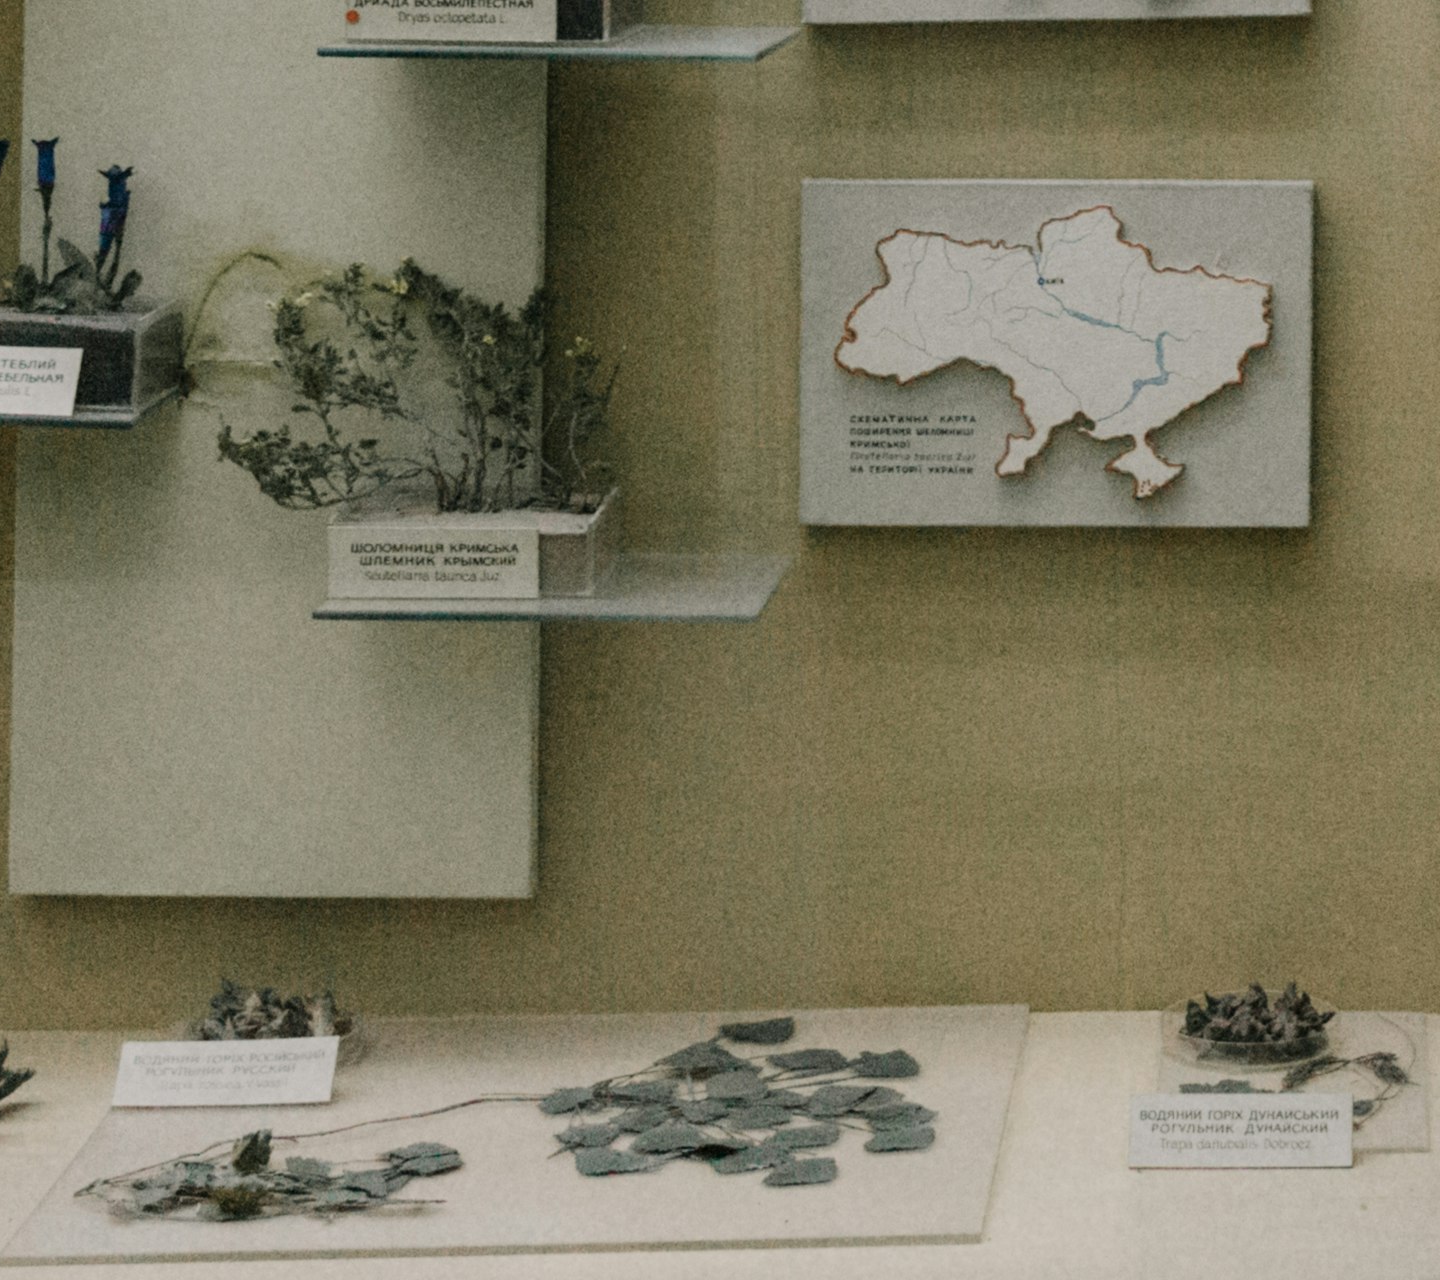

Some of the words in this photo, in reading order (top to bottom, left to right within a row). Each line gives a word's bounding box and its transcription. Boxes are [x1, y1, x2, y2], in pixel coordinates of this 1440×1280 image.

[849, 414, 929, 424] СХЕМАТИЧНА
[940, 415, 976, 423] КАРТА
[849, 427, 912, 436] ПОШИРЕННЯ
[350, 543, 444, 555] ШОЛОМНИЦЯ
[449, 543, 519, 554] КРИМСЬКА
[359, 556, 435, 567] ШЛЕМНИК
[443, 556, 516, 567] КРЫМСКИЙ
[1139, 1109, 1202, 1122] ВОДЯНИЙ
[1207, 1109, 1243, 1121] ГОРІХ
[1248, 1109, 1339, 1122] ДУНАЙСЬКИЙ
[1151, 1123, 1234, 1135] РОГУЛЬНИК
[1244, 1123, 1329, 1135] ДУНАЙСКИЙ
